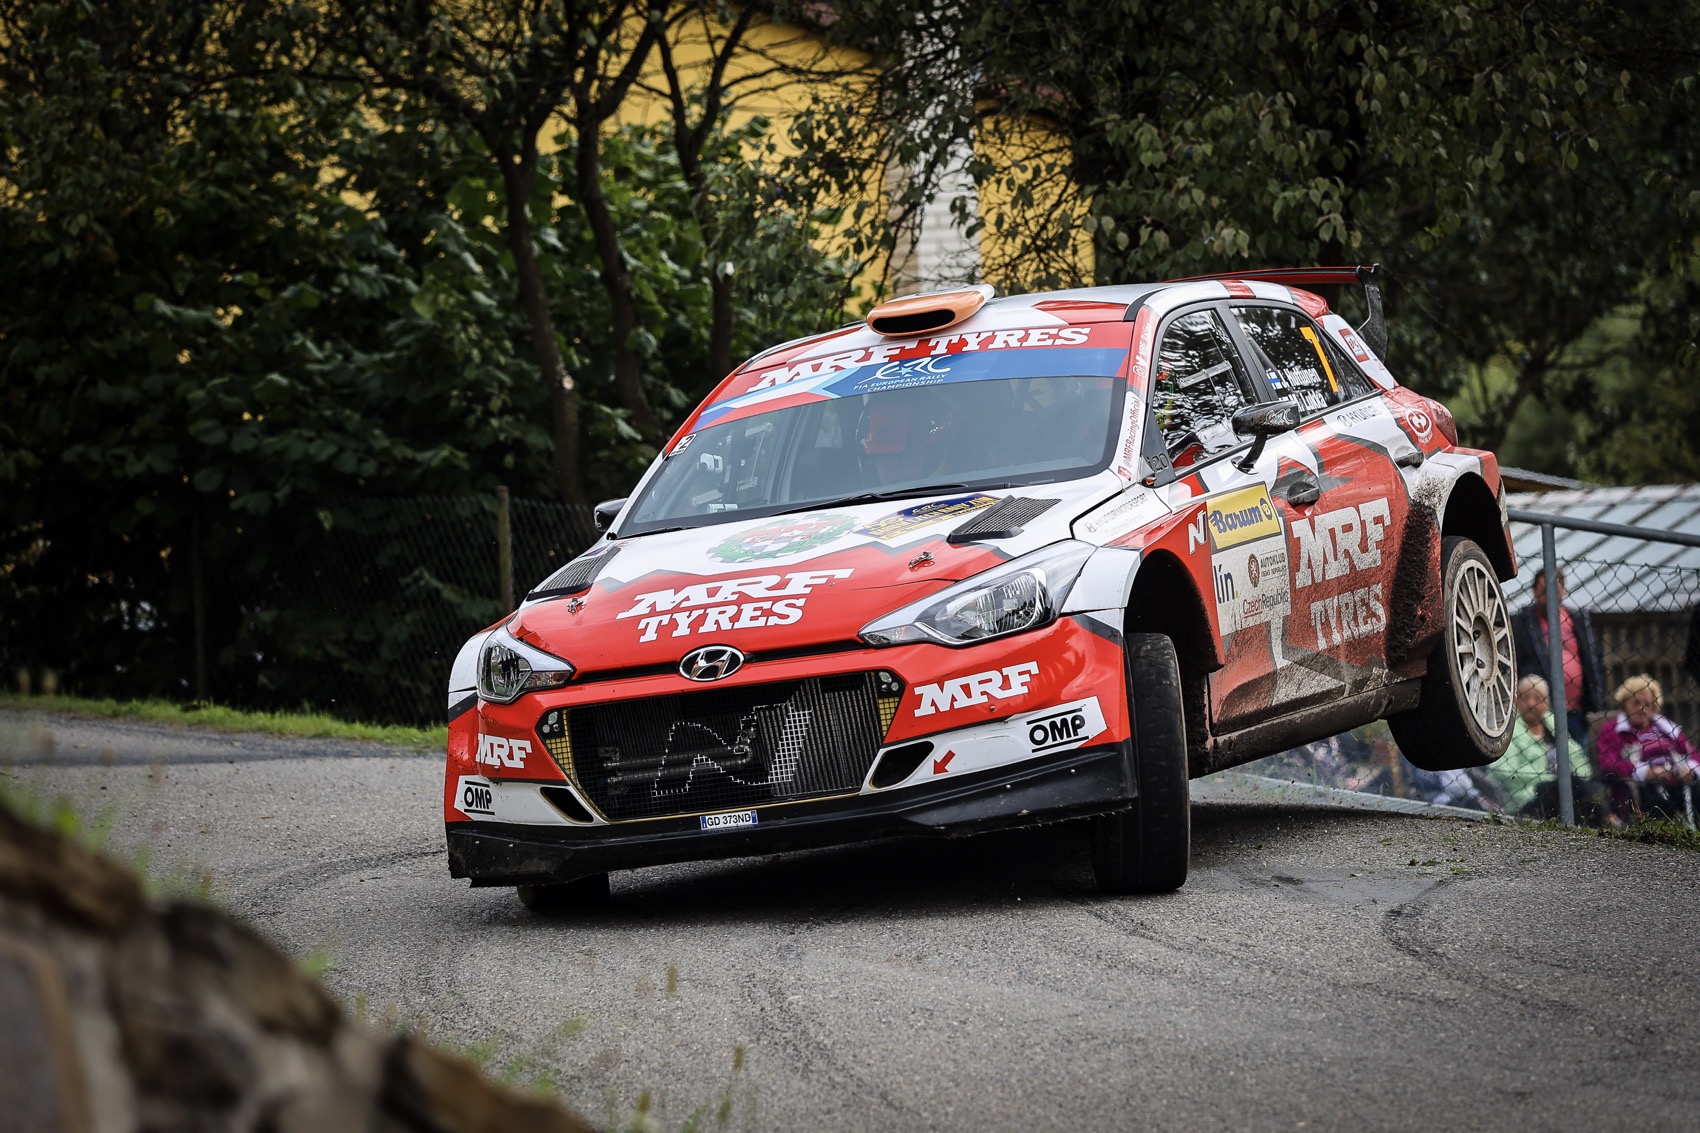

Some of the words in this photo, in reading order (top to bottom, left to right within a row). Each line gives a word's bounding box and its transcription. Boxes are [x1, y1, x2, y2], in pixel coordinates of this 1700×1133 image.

[746, 339, 920, 393] MRF
[928, 328, 1092, 356] TYRES
[867, 379, 944, 393] CHAMPIONSHIP
[871, 377, 918, 387] EUROPEAN
[919, 373, 948, 381] RALLY
[1283, 366, 1322, 388] Huttunen
[1208, 509, 1264, 534] Barum
[1290, 497, 1392, 589] MRF
[1260, 552, 1286, 569] AUTOKLUB
[615, 567, 855, 620] MRF
[637, 597, 807, 643] TYRES
[1310, 582, 1387, 651] TYRES
[913, 660, 1041, 718] MRF
[1029, 714, 1086, 746] OMP
[475, 732, 533, 769] MRF
[463, 786, 493, 810] OMP
[706, 815, 721, 827] GD
